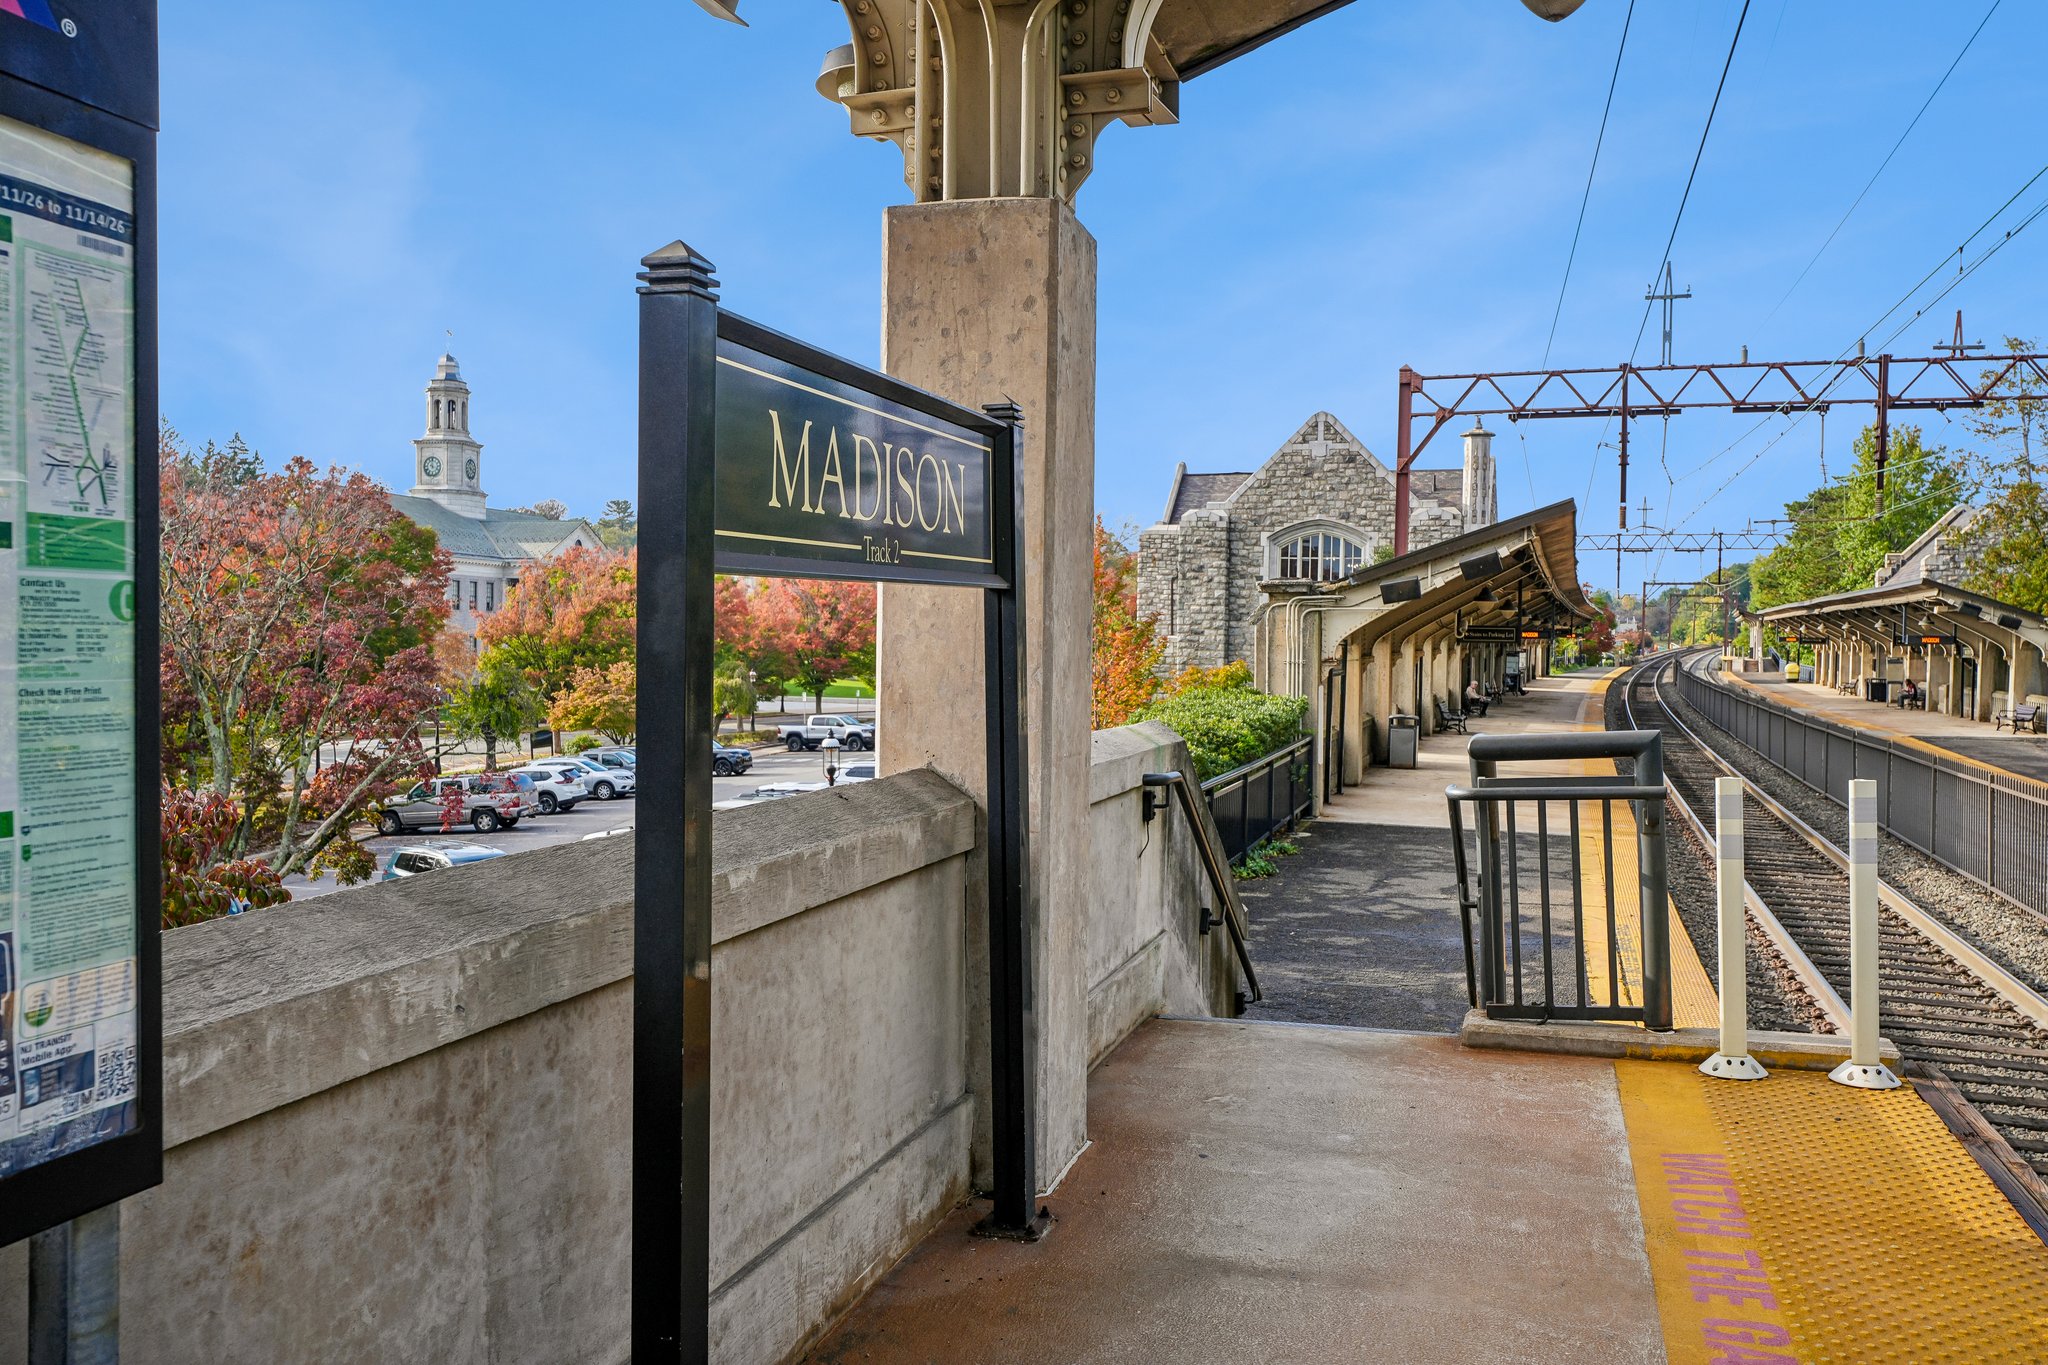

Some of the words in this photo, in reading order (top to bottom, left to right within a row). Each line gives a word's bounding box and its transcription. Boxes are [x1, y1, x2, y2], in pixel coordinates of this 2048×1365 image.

[48, 199, 61, 215] to
[66, 205, 126, 234] 11/14/26
[768, 409, 966, 536] MADISON
[863, 535, 891, 563] Track
[893, 539, 899, 564] 2
[20, 578, 53, 587] Contact
[55, 579, 66, 588] Us
[18, 688, 44, 697] Check
[47, 687, 61, 696] the
[83, 685, 102, 695] Print
[35, 1034, 72, 1049] TRANSIT
[21, 1051, 53, 1066] Mobile
[1660, 1153, 1752, 1239] WATCH
[1683, 1250, 1778, 1310] THE
